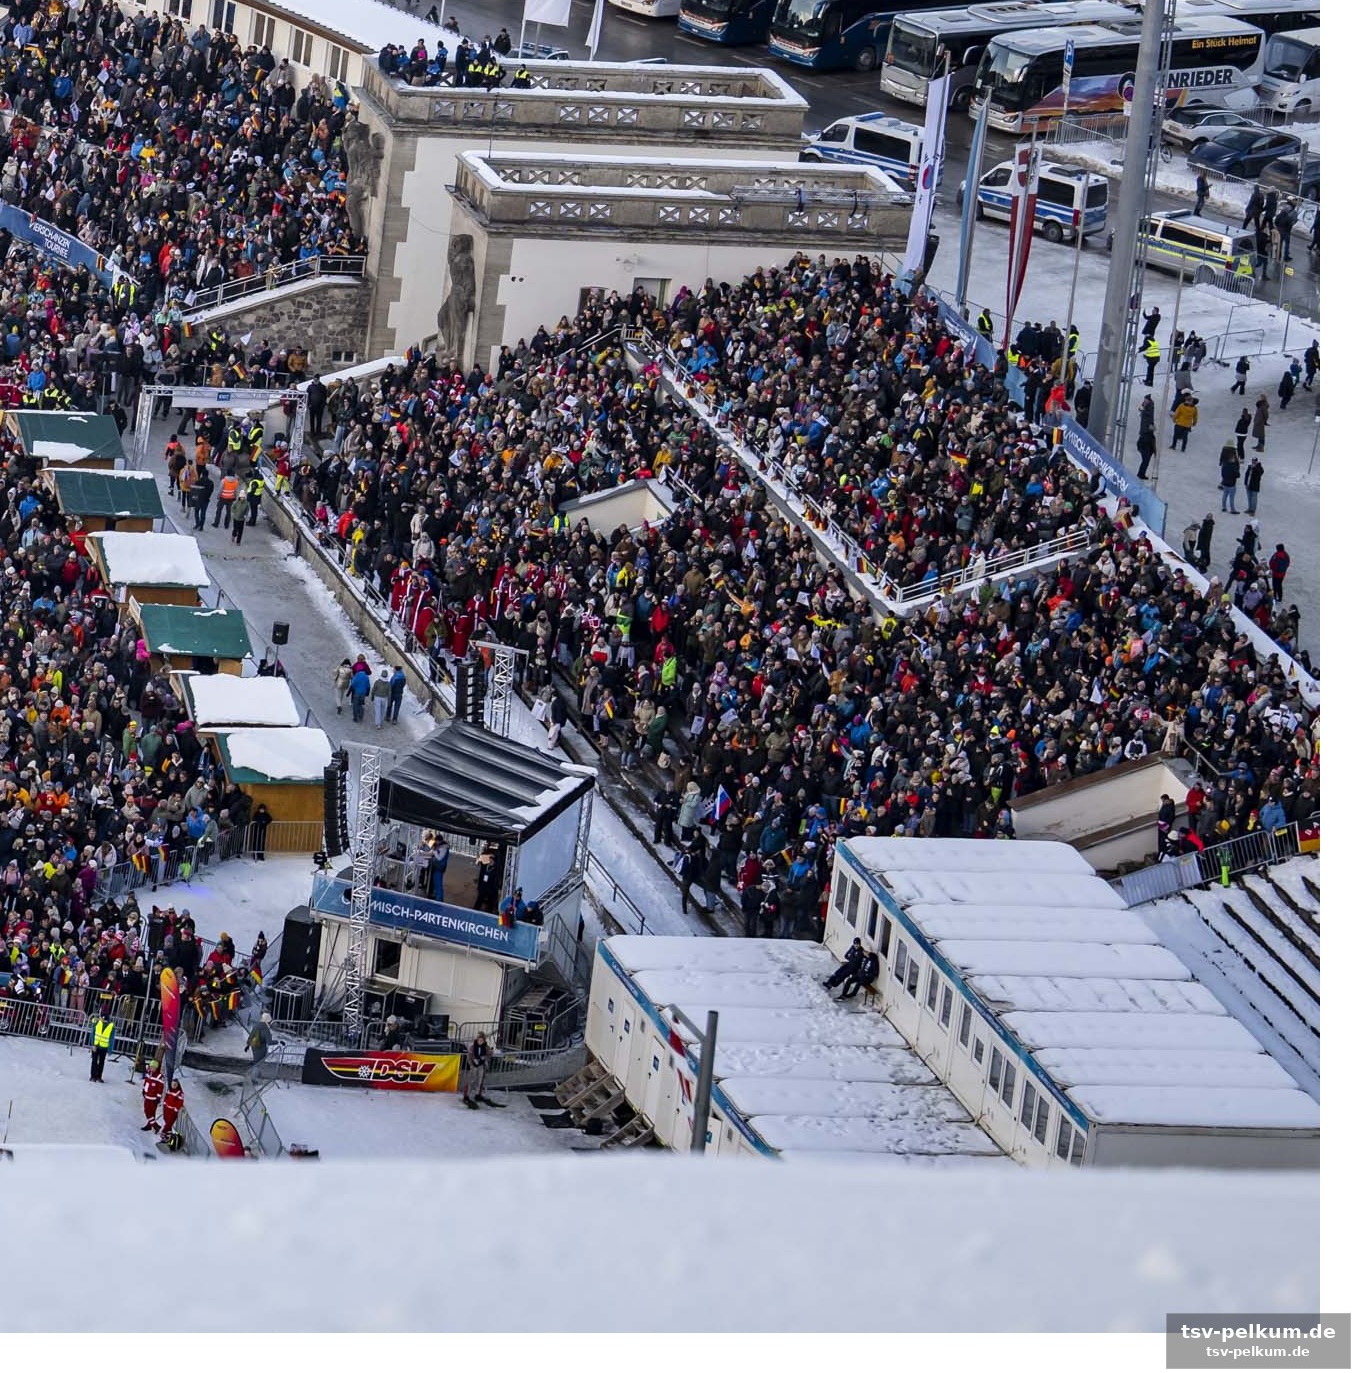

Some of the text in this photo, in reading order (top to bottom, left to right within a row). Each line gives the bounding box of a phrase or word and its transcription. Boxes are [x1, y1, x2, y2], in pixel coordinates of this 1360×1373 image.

[1191, 39, 1204, 50] Ein
[1228, 36, 1257, 47] Heimat
[341, 893, 509, 942] GMISCH-PARTENKIRCHEN
[379, 1058, 437, 1083] DSV
